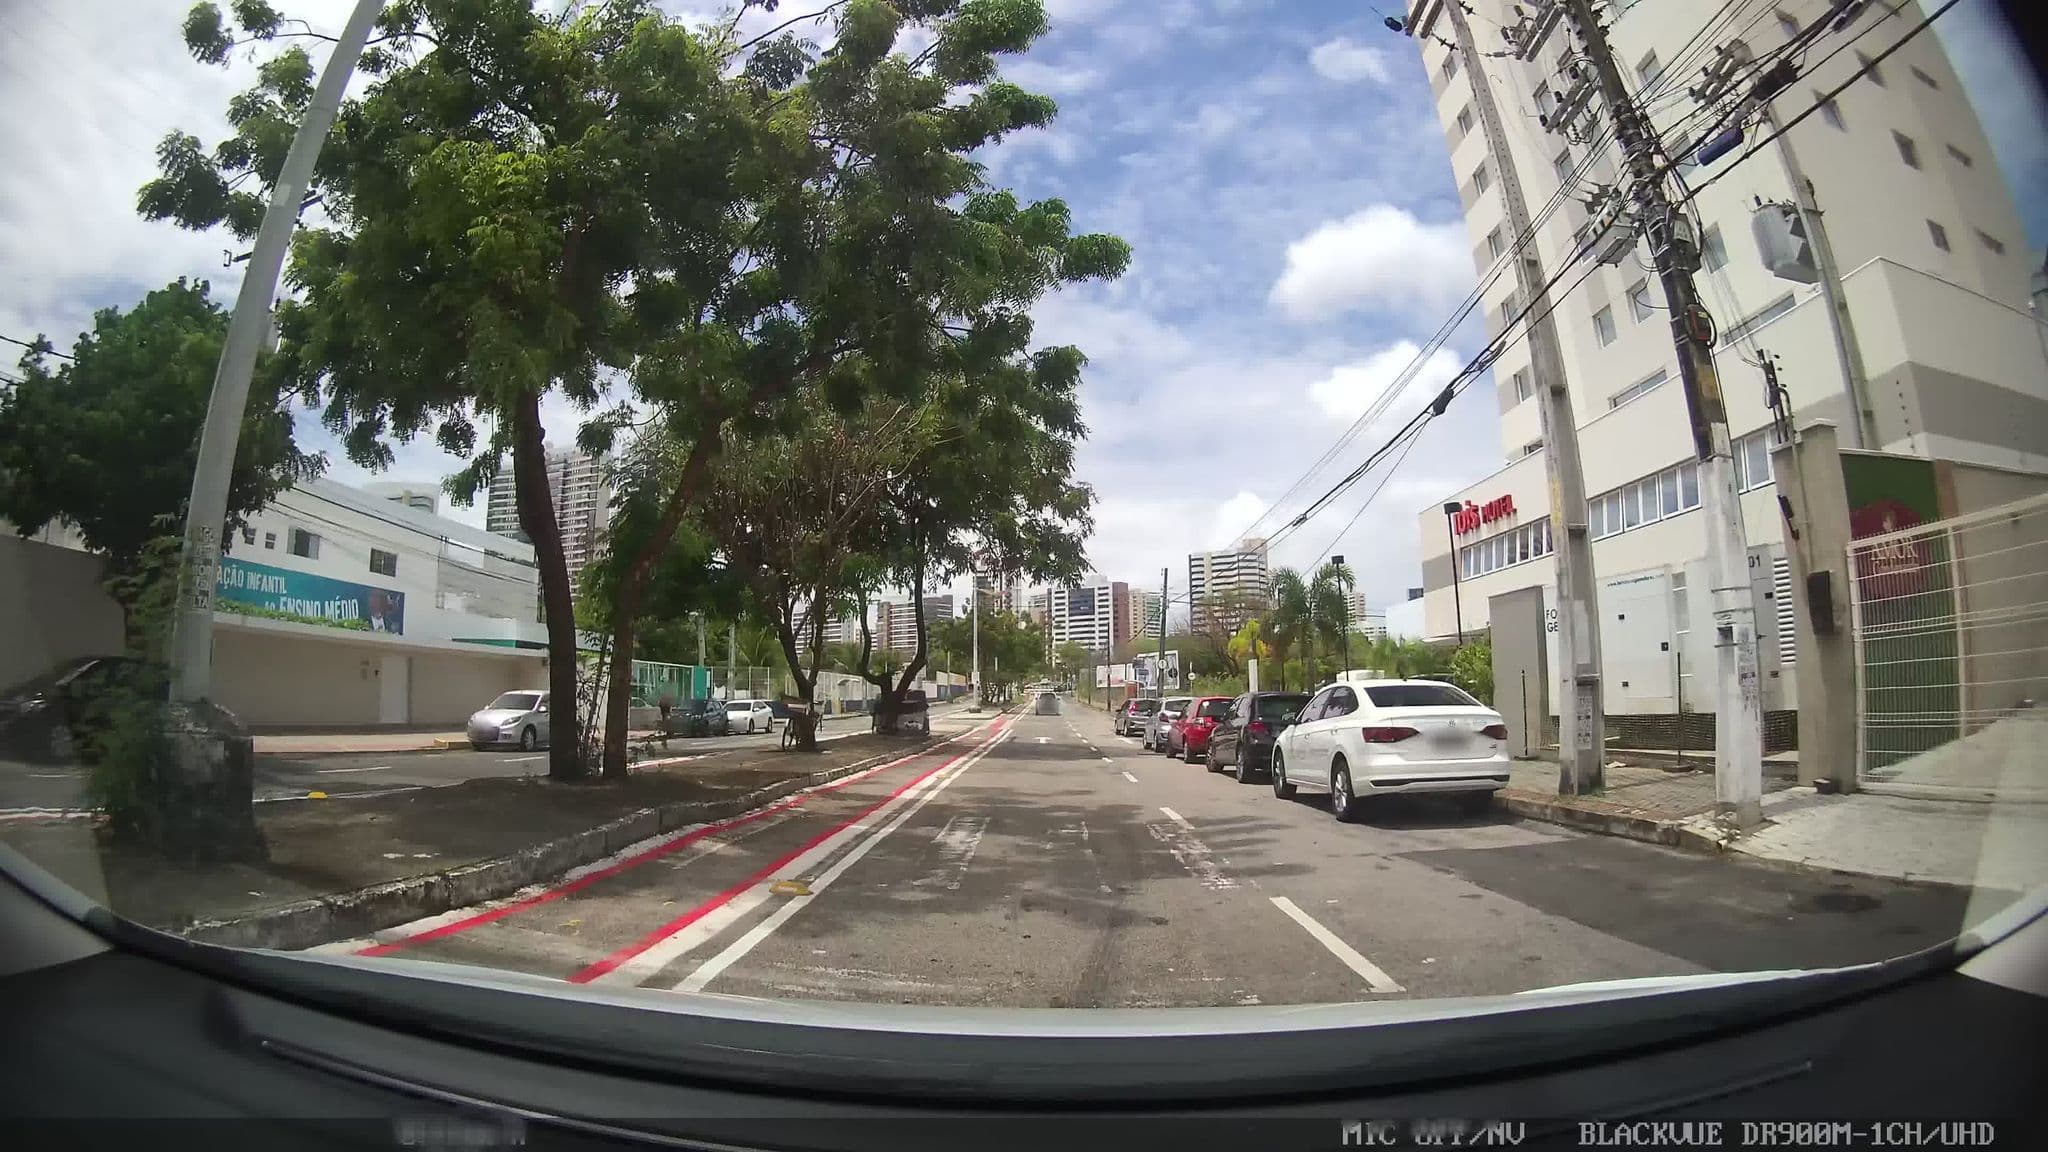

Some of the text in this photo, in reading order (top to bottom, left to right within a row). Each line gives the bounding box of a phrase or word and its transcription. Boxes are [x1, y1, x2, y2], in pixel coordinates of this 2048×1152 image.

[246, 571, 288, 594] INFANTIL
[279, 595, 321, 619] ENSINO
[324, 594, 360, 622] MÉDIO
